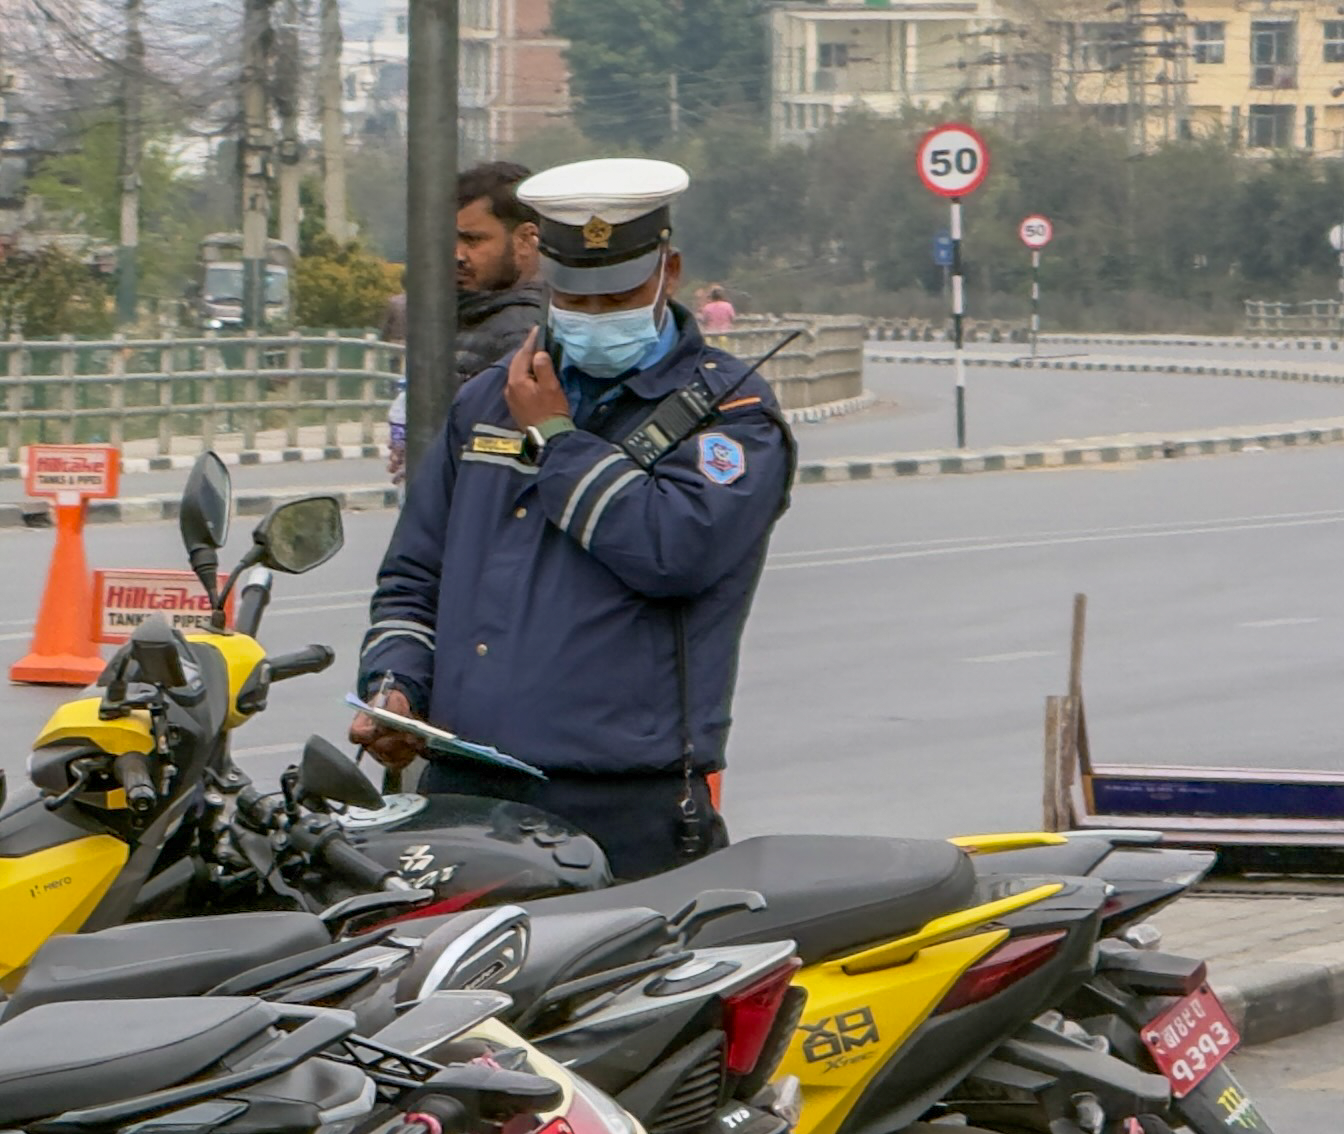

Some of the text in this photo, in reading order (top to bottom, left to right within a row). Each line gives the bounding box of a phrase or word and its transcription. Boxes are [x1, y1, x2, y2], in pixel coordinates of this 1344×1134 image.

[930, 148, 977, 176] 50
[1026, 224, 1045, 237] 50
[37, 457, 104, 473] Hilltake
[39, 475, 65, 484] TANKS
[78, 476, 102, 485] PIPES
[106, 586, 212, 611] Hilltake
[1172, 1021, 1231, 1081] १३१३
